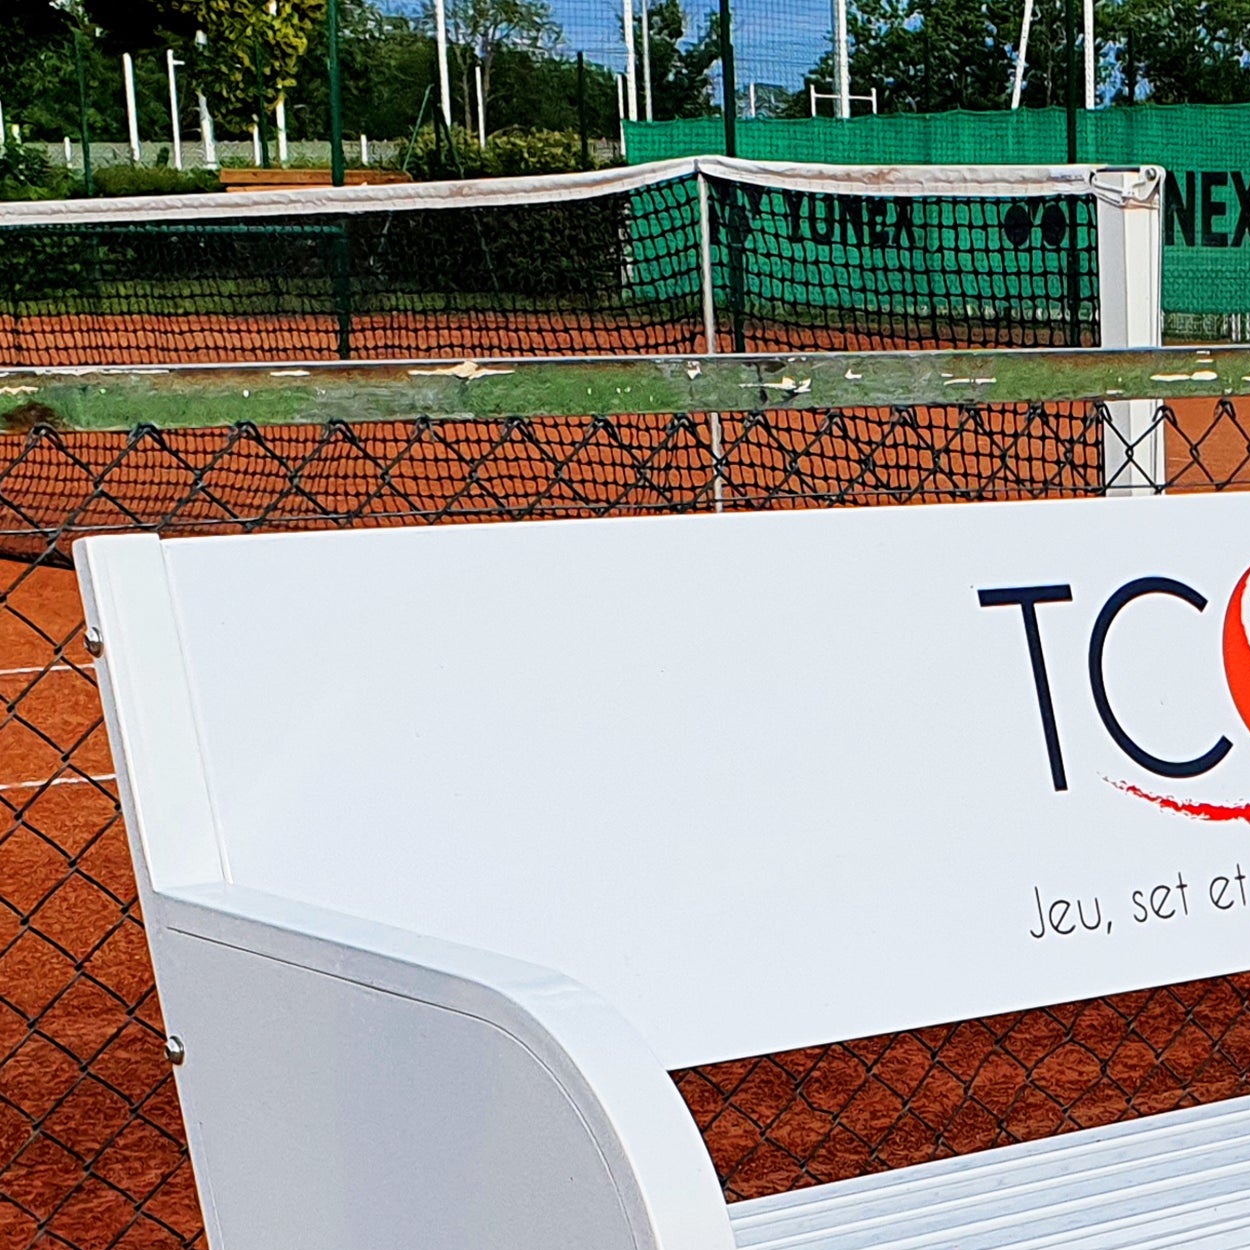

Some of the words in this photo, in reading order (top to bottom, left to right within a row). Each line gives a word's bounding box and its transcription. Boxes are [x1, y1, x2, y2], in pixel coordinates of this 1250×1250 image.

[1030, 886, 1112, 938] Jeu,
[1132, 872, 1188, 923] set
[1209, 863, 1246, 909] et
